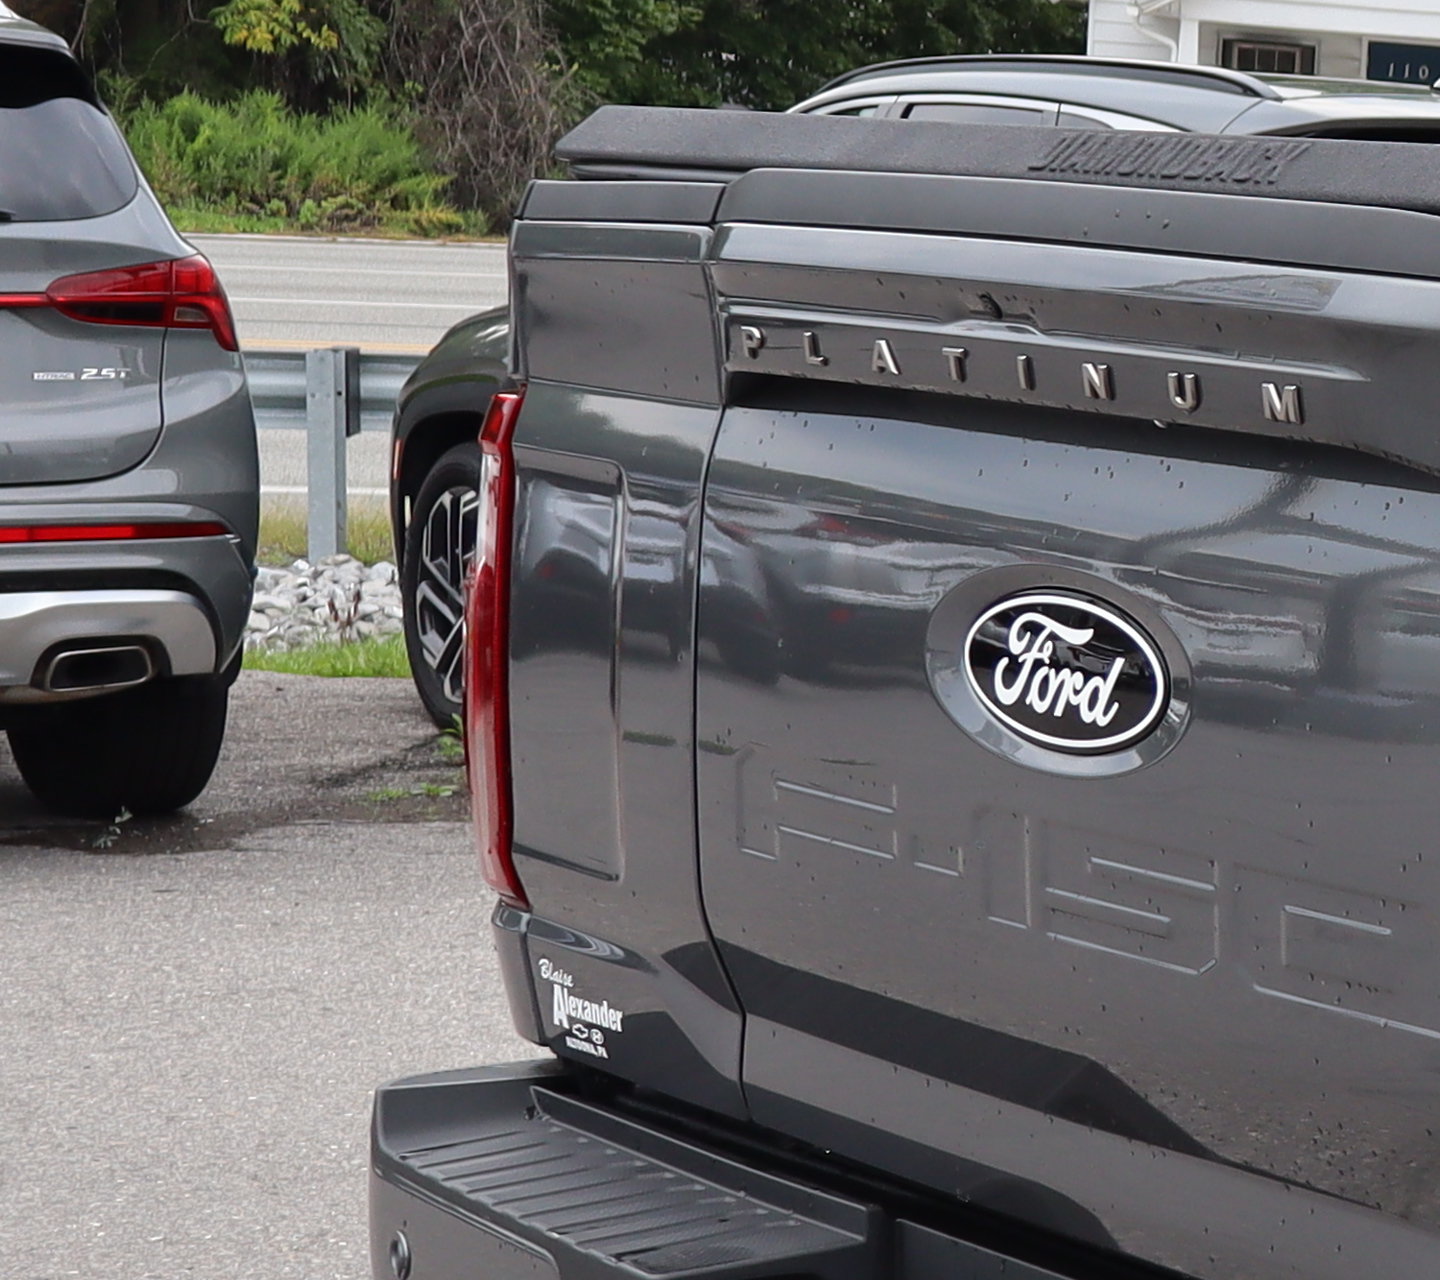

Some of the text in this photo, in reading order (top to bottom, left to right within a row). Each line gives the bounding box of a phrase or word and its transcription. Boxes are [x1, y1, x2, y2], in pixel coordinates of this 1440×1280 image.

[1388, 62, 1430, 80] 110
[739, 325, 1304, 425] PLATINUM
[994, 611, 1127, 728] Ford
[538, 958, 574, 988] Blaise
[553, 983, 623, 1032] Alexander
